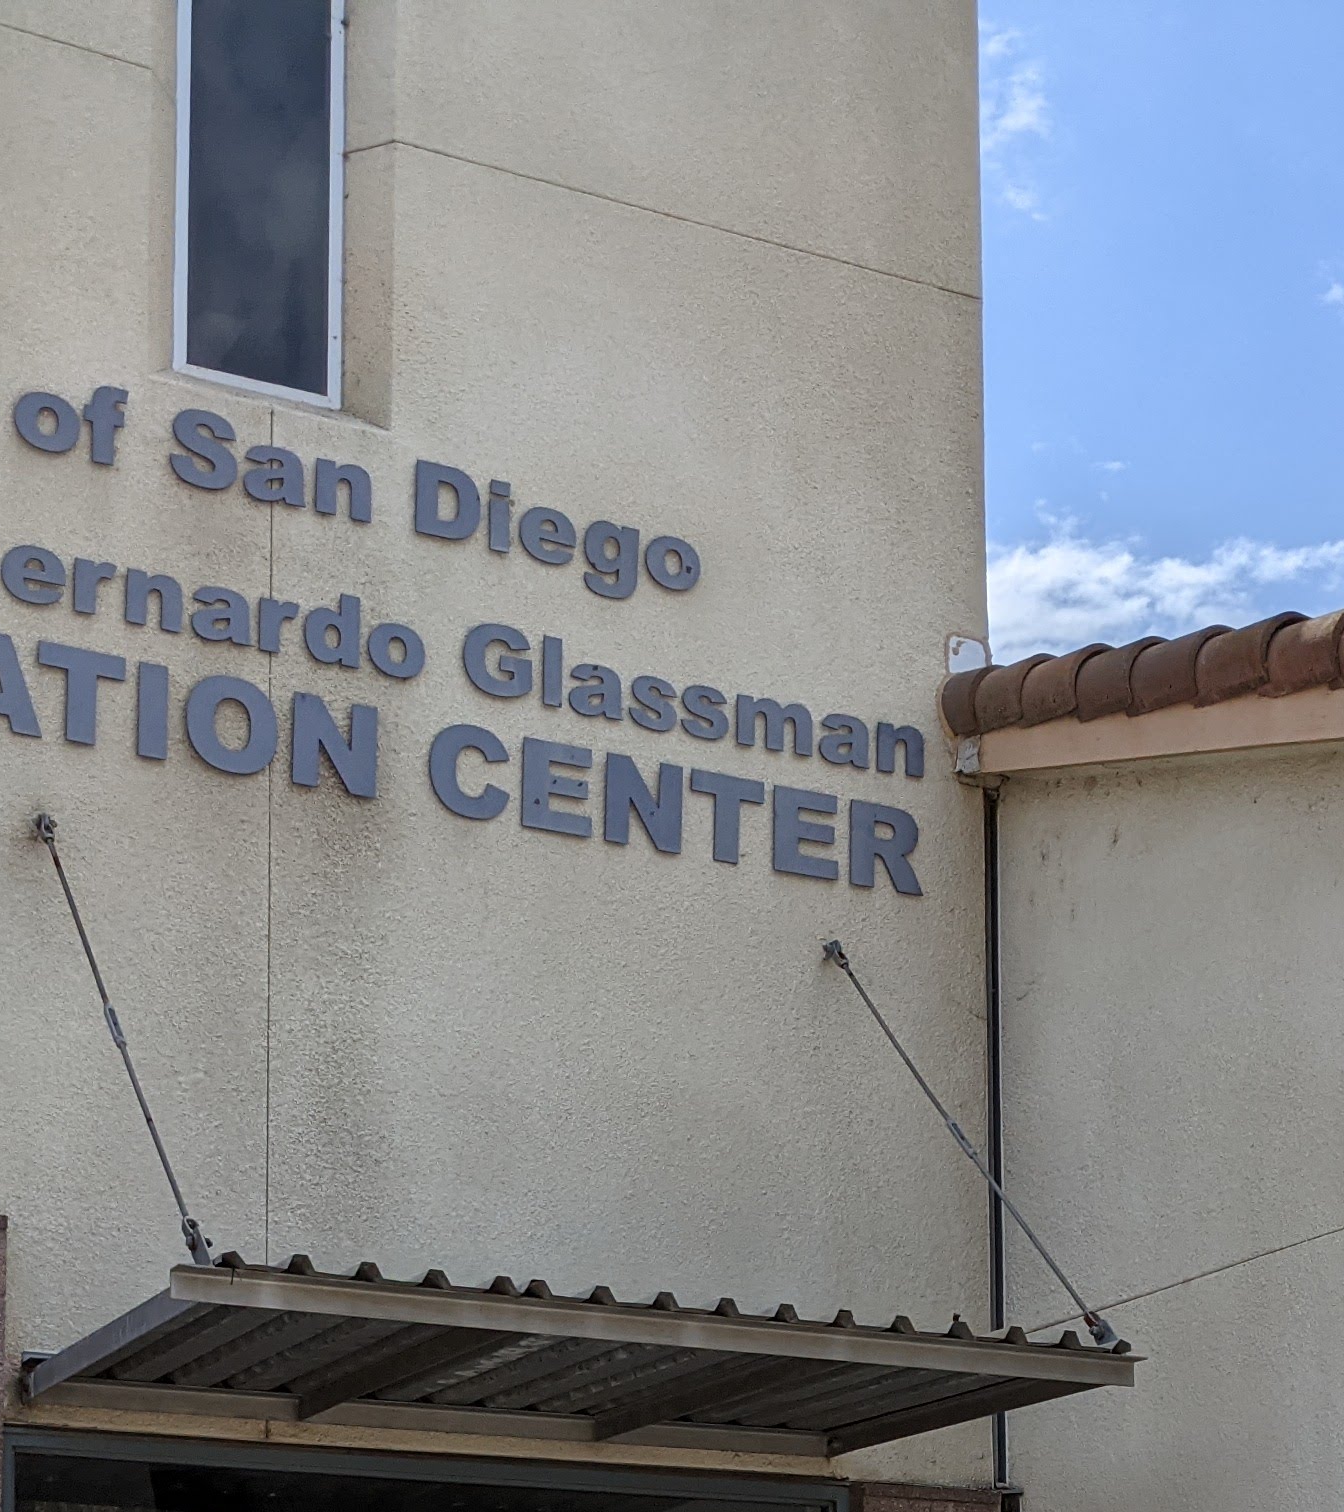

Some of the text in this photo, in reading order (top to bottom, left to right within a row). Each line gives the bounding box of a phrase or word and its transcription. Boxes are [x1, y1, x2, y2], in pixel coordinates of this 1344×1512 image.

[14, 386, 128, 465] of
[170, 408, 373, 524] San
[413, 459, 701, 599] Diego
[462, 622, 925, 777] Glassman
[428, 723, 923, 895] CENTER
